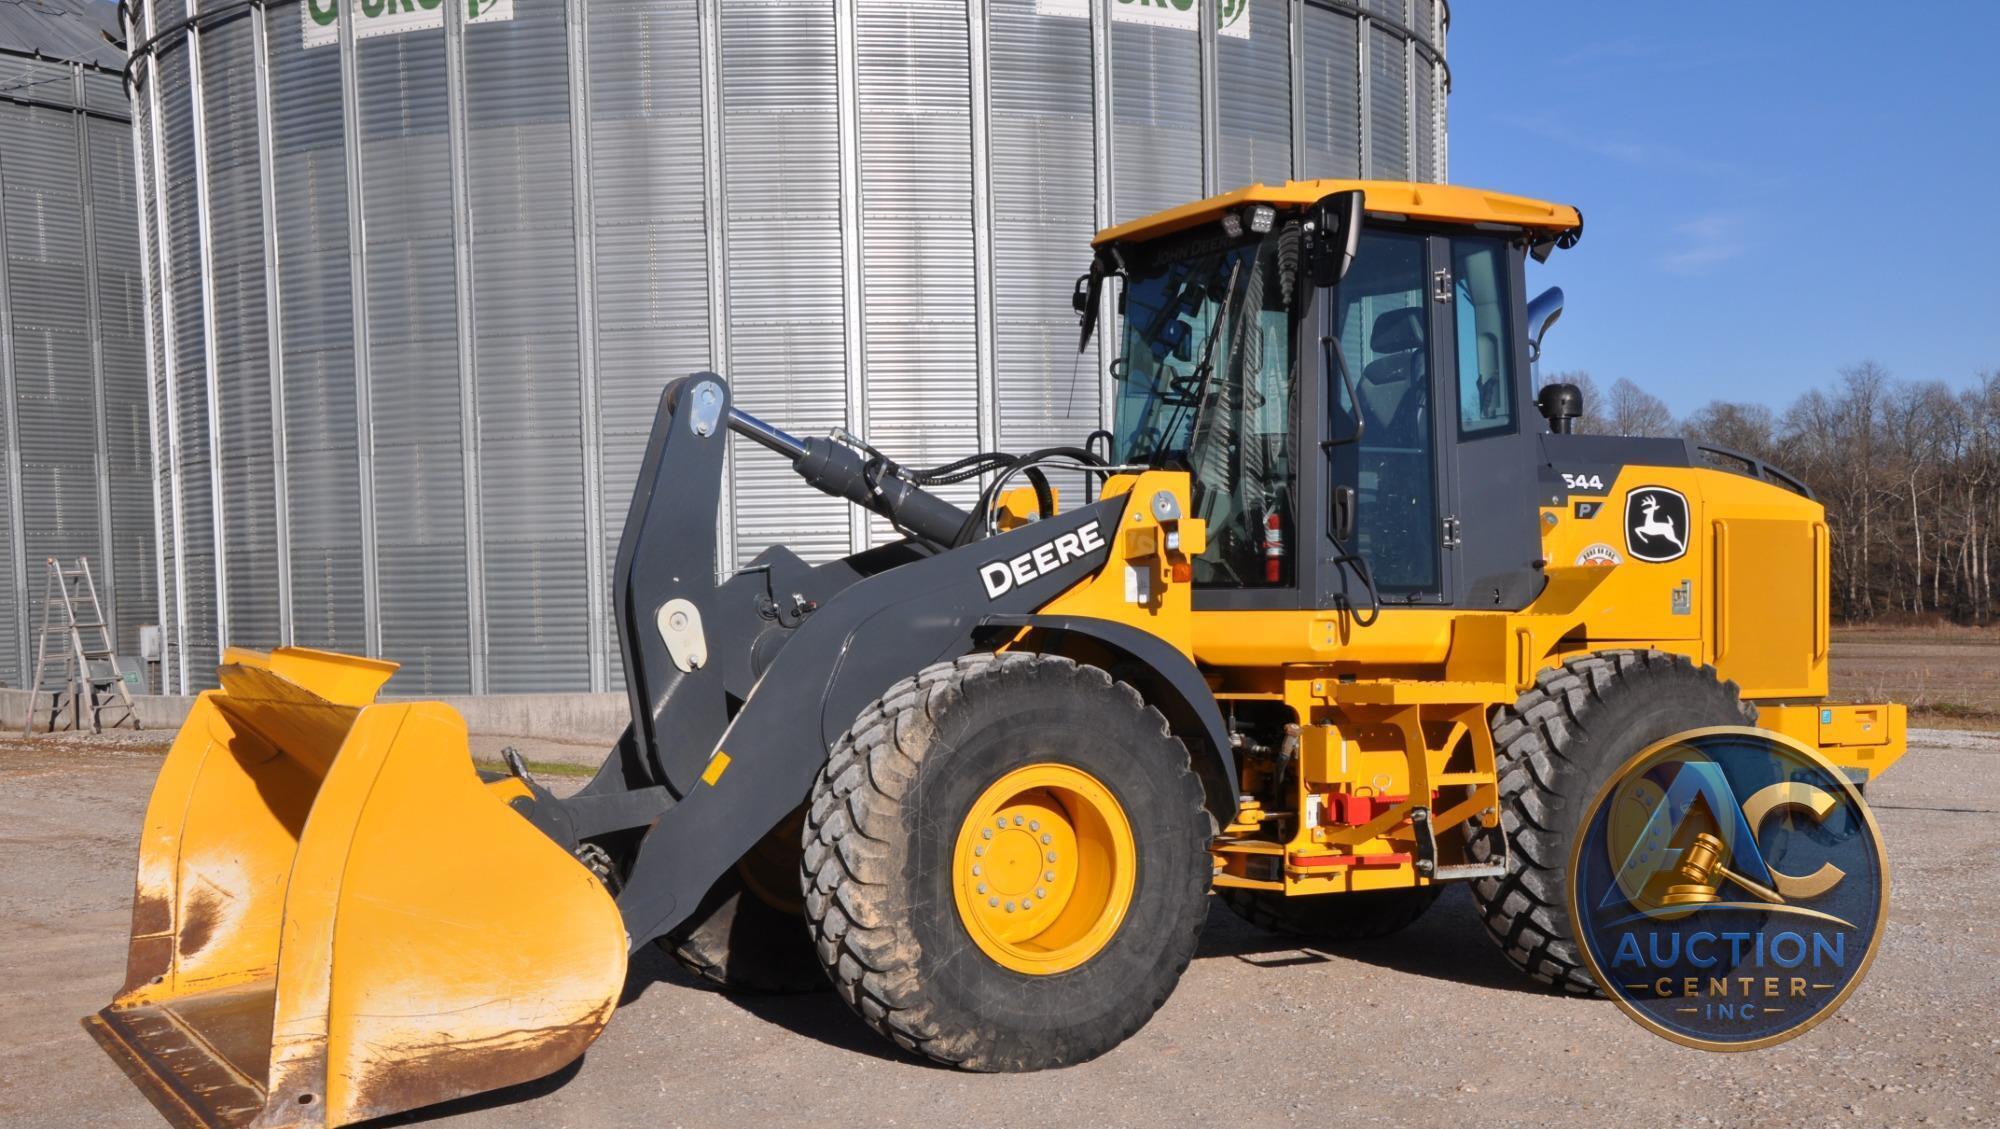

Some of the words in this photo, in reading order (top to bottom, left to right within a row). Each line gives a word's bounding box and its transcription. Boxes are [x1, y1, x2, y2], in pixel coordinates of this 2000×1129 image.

[1561, 473, 1603, 489] 544
[1579, 503, 1591, 517] P
[980, 521, 1105, 599] DEERE
